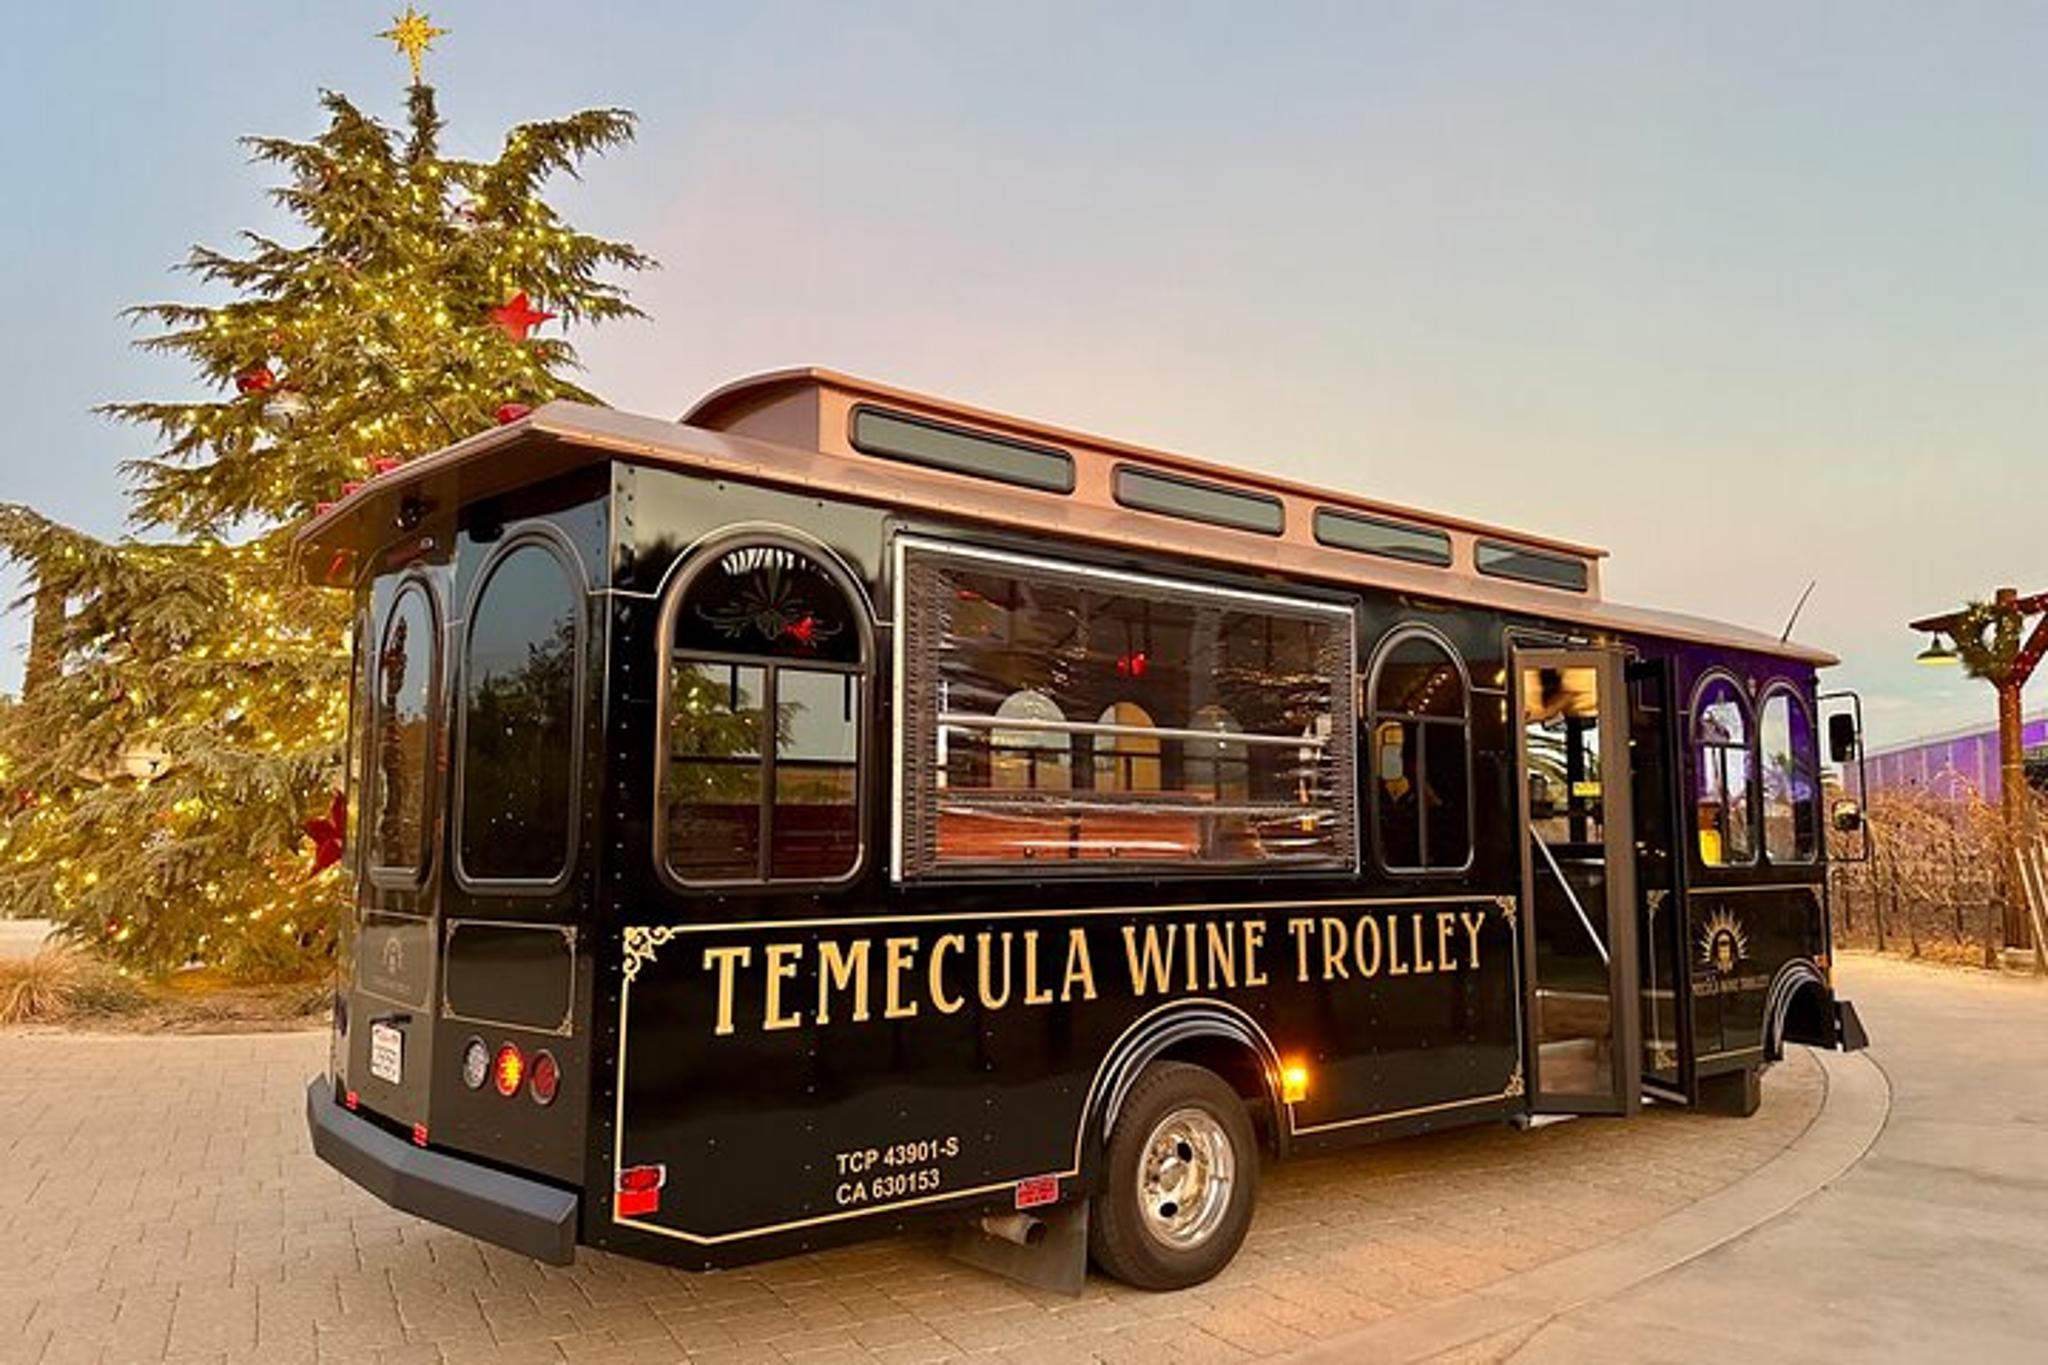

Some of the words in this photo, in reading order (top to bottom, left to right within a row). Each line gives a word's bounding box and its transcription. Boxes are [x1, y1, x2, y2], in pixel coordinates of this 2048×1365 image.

[703, 927, 1098, 1036] TEMECULA
[1121, 920, 1269, 997] WINE
[1288, 911, 1486, 983] TROLLEY
[836, 1149, 879, 1174] TCP
[884, 1137, 959, 1166] 43901-S
[836, 1182, 867, 1204] CA
[873, 1168, 939, 1198] 630153
